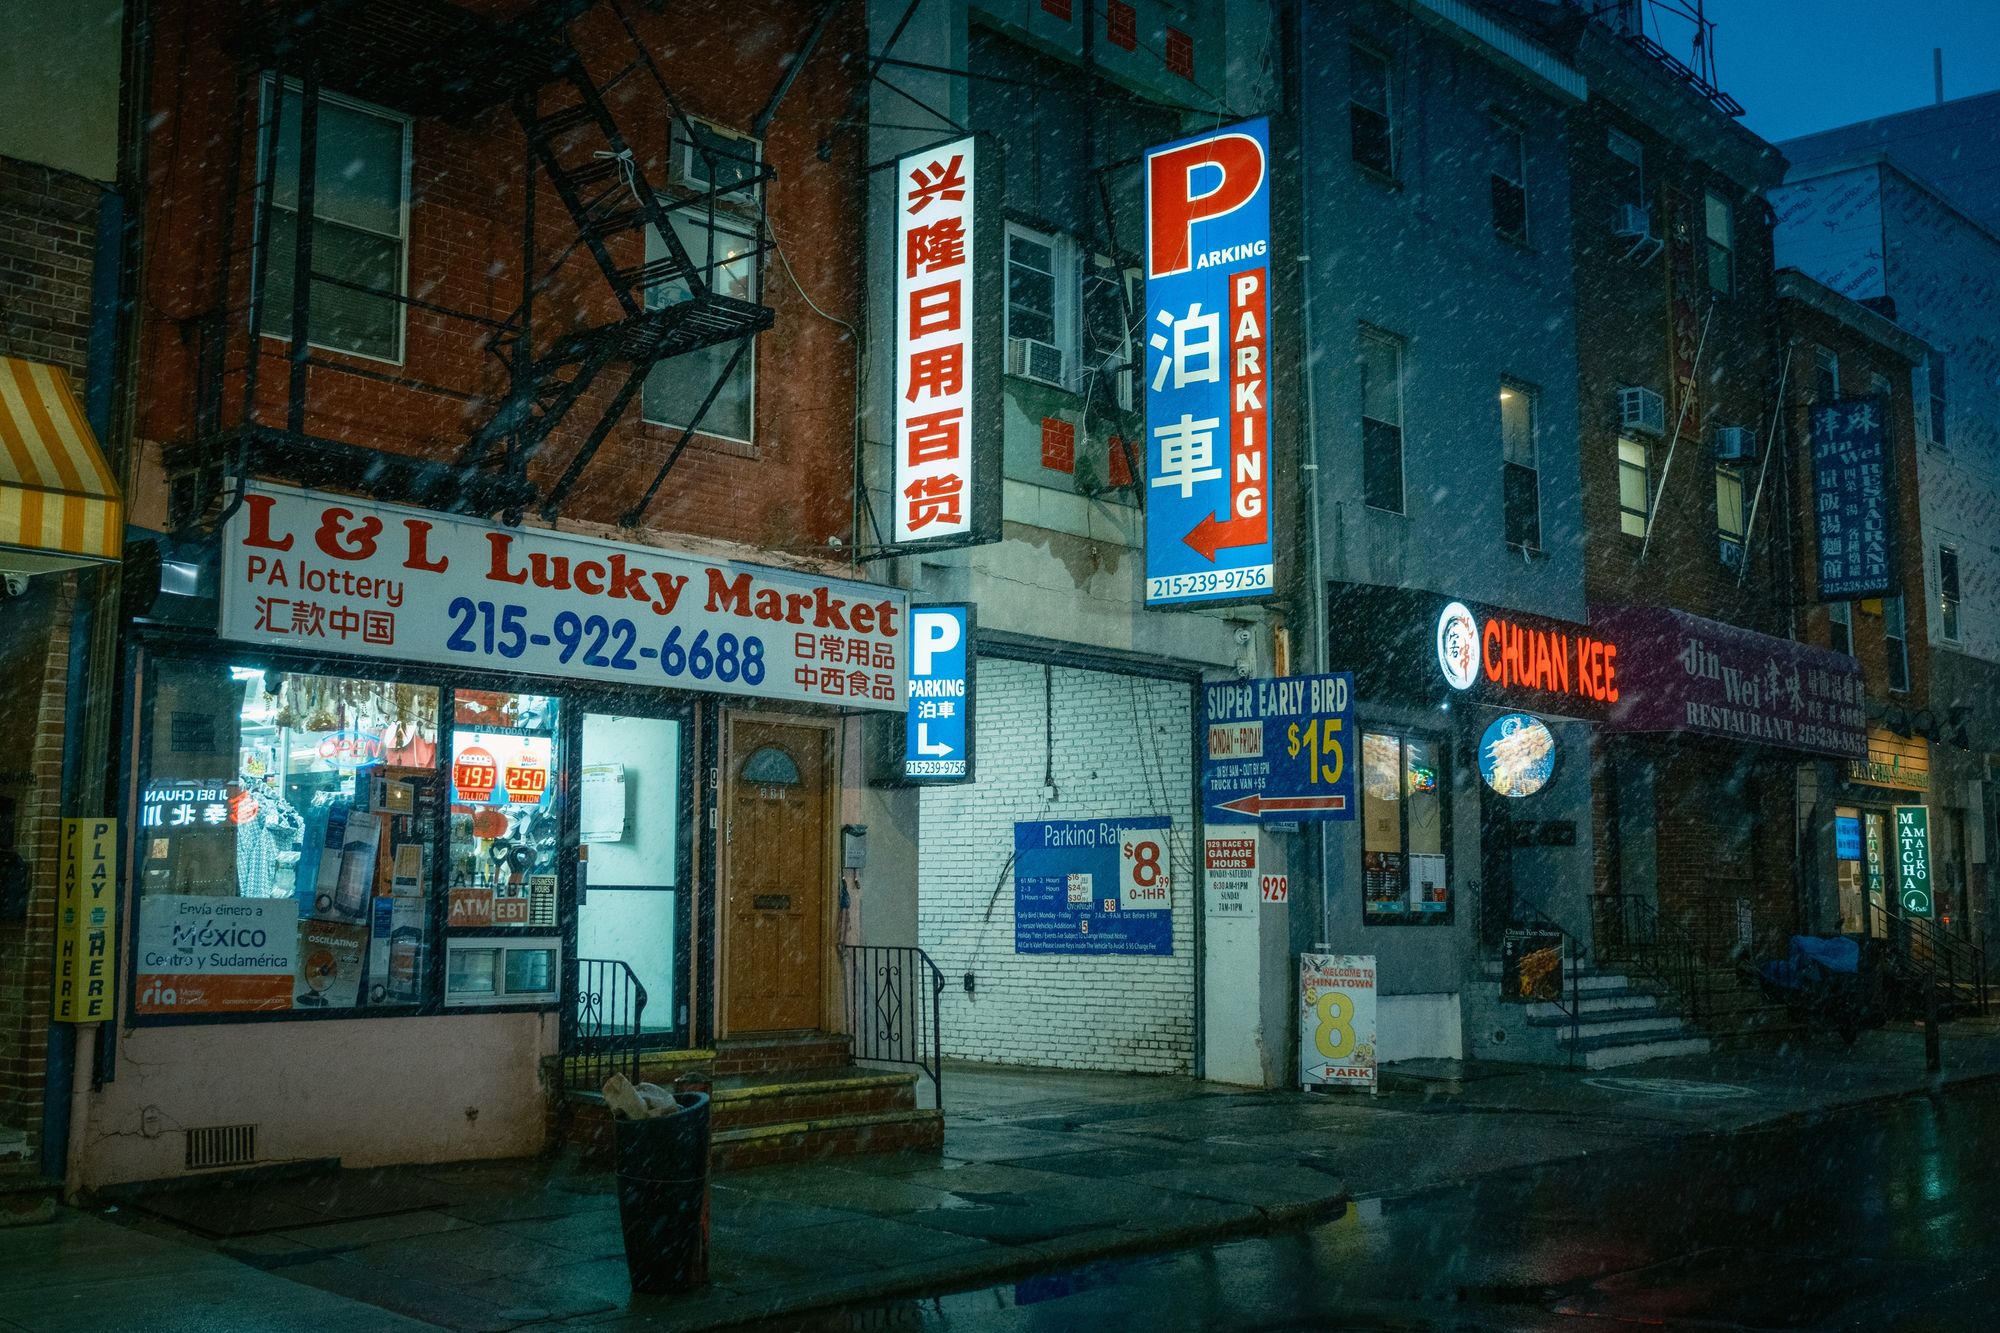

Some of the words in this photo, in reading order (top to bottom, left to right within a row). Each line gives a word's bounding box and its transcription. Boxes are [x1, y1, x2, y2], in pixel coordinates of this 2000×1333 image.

[904, 154, 967, 532] 兴隆日用百货
[1150, 303, 1222, 498] 泊車
[1235, 275, 1262, 519] PARKING
[1817, 440, 1852, 458] Jin
[1840, 443, 1881, 464] Wei
[1860, 463, 1885, 575] RESTAURANT
[243, 494, 294, 552] L
[315, 507, 377, 560] &
[403, 520, 449, 574] L
[485, 532, 688, 615] Lucky
[704, 568, 899, 638] Market
[247, 555, 289, 588] PA
[300, 558, 404, 608] lottery
[1153, 566, 1266, 598] 215-239-9756
[1824, 579, 1888, 594] 215-238-8855
[254, 596, 395, 646] 汇款中国
[447, 596, 765, 686] 215-922-6688
[794, 632, 895, 670] 日常用品
[913, 613, 960, 675] P
[1483, 618, 1569, 694] CHUAN
[1577, 636, 1619, 703] KEE
[794, 666, 895, 701] 中西食品
[1684, 638, 1720, 680] Jin
[1721, 666, 1761, 709] Wei
[908, 678, 965, 698] PARKING
[1208, 685, 1253, 720] SUPER
[1259, 680, 1304, 717] EARLY
[1311, 677, 1348, 713] BIRD
[918, 701, 956, 719] 泊車
[474, 724, 497, 734] PLAY
[1686, 701, 1794, 741] RESTAURANT
[1798, 723, 1867, 754] 215-238-8855
[319, 739, 382, 758] OPEN
[1240, 727, 1262, 754] FRIDAY
[1287, 719, 1344, 784] $15
[464, 767, 494, 787] 193
[508, 769, 544, 789] 250
[906, 760, 965, 775] 215-239-9756
[458, 791, 489, 801] MILLION
[1211, 778, 1232, 790] TRUCK
[1240, 778, 1253, 790] VAN
[509, 794, 540, 803] MILLION
[1045, 824, 1095, 849] Parking
[1100, 823, 1136, 844] Rat
[1243, 840, 1253, 848] ST
[66, 824, 77, 899] PLAY
[91, 823, 109, 899] PLAY
[1208, 849, 1252, 858] GARAGE
[1899, 813, 1916, 889] MATCHA
[1913, 828, 1926, 880] MAIKO
[1213, 859, 1247, 868] HOURS
[531, 878, 554, 886] BUSINESS
[534, 885, 551, 893] HOURS
[1129, 888, 1165, 900] 0-1HR
[1262, 876, 1287, 901] 929
[452, 899, 490, 917] ATM
[1104, 900, 1115, 911] 38
[1221, 892, 1240, 900] SUNDAY
[179, 902, 212, 917] Envía
[215, 904, 253, 916] dinero
[255, 907, 263, 917] a
[496, 902, 526, 918] EBT
[173, 919, 266, 948] México
[308, 935, 359, 948] OSCILLATING
[145, 952, 193, 967] Centro
[197, 956, 206, 970] y
[209, 952, 288, 968] Sudamérica
[1321, 967, 1361, 977] WELCOME
[1363, 968, 1373, 978] TO
[61, 941, 74, 1016] HERE
[88, 936, 105, 1016] HERE
[1304, 978, 1373, 988] CHINATOWN
[142, 980, 177, 1005] ria
[1326, 1067, 1370, 1078] PARK
